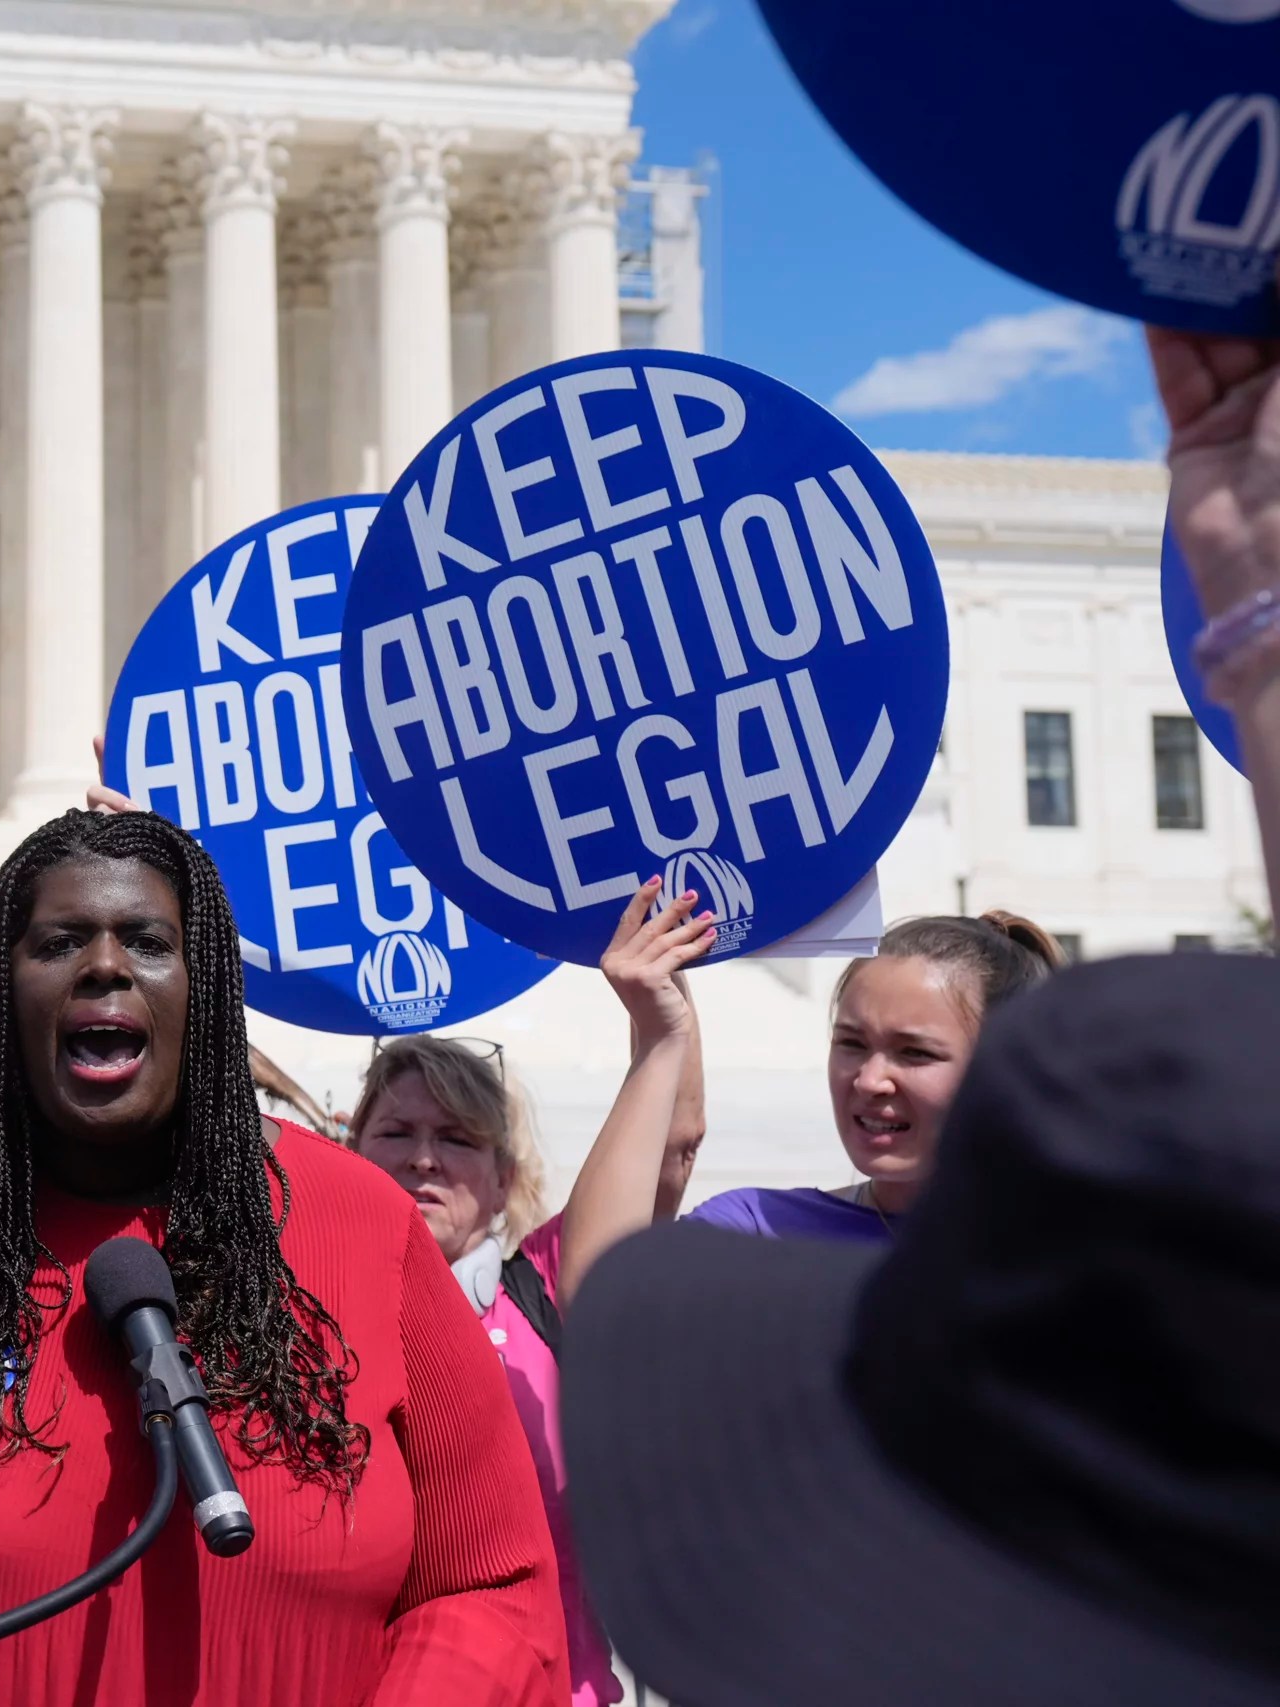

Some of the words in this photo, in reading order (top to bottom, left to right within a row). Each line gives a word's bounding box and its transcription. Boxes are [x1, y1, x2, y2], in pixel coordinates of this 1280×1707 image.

[403, 366, 746, 591] KEEP
[362, 464, 914, 783] ABORTION
[440, 668, 894, 913] LEGAL
[357, 933, 452, 1006] NOW
[369, 1000, 447, 1015] NATIONAL
